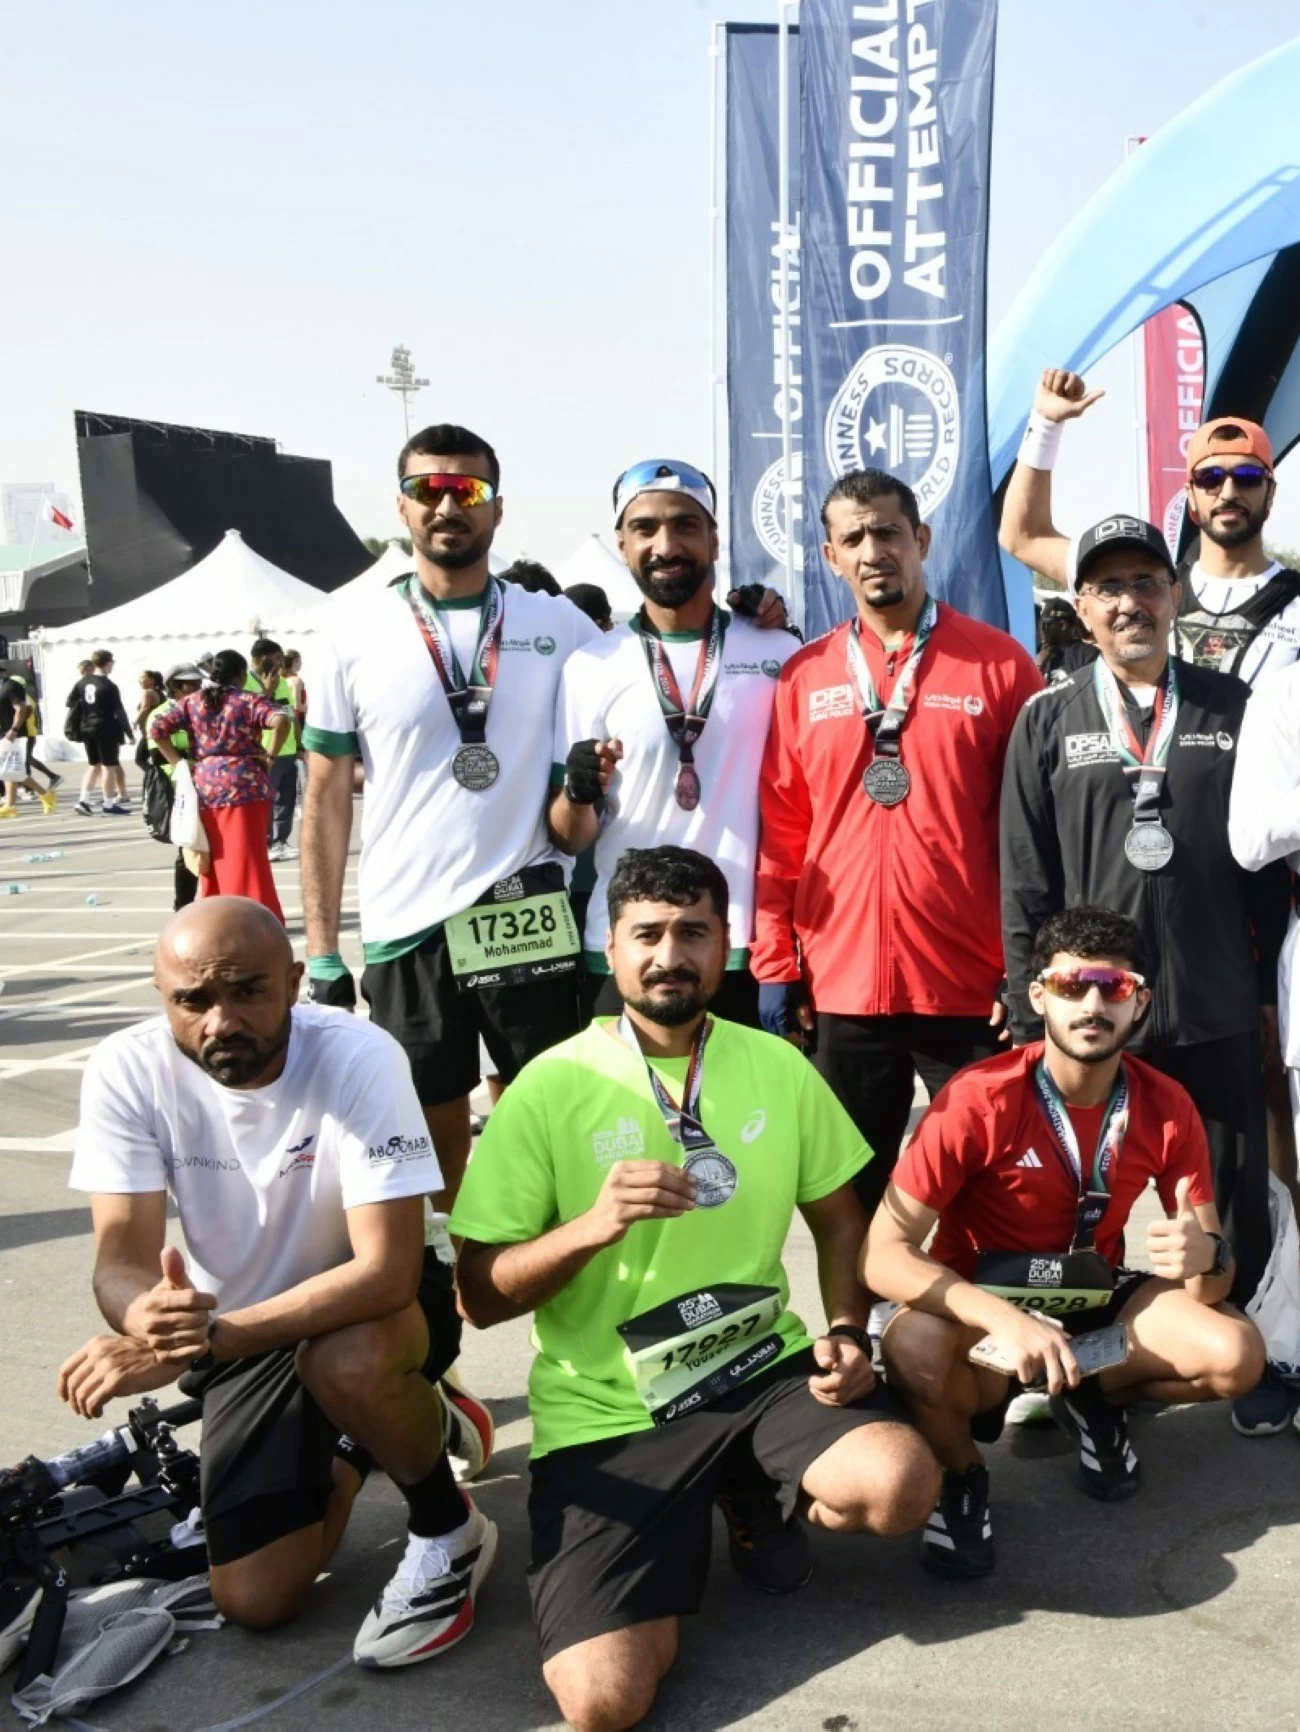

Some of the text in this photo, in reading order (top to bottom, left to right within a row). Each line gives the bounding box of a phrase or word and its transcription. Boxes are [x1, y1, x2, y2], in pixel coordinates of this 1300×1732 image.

[848, 0, 898, 300] OFFICIAL
[884, 356, 955, 445] RECORDS
[1176, 306, 1204, 458] FFICIA
[837, 373, 869, 474] INNESS
[84, 684, 96, 704] 8
[468, 905, 556, 944] 17328
[484, 936, 553, 958] Mohammad
[1029, 1269, 1062, 1279] DUBAI
[681, 1300, 719, 1321] DUBAI
[1001, 1296, 1089, 1311] 7928
[662, 1314, 761, 1371] 17927
